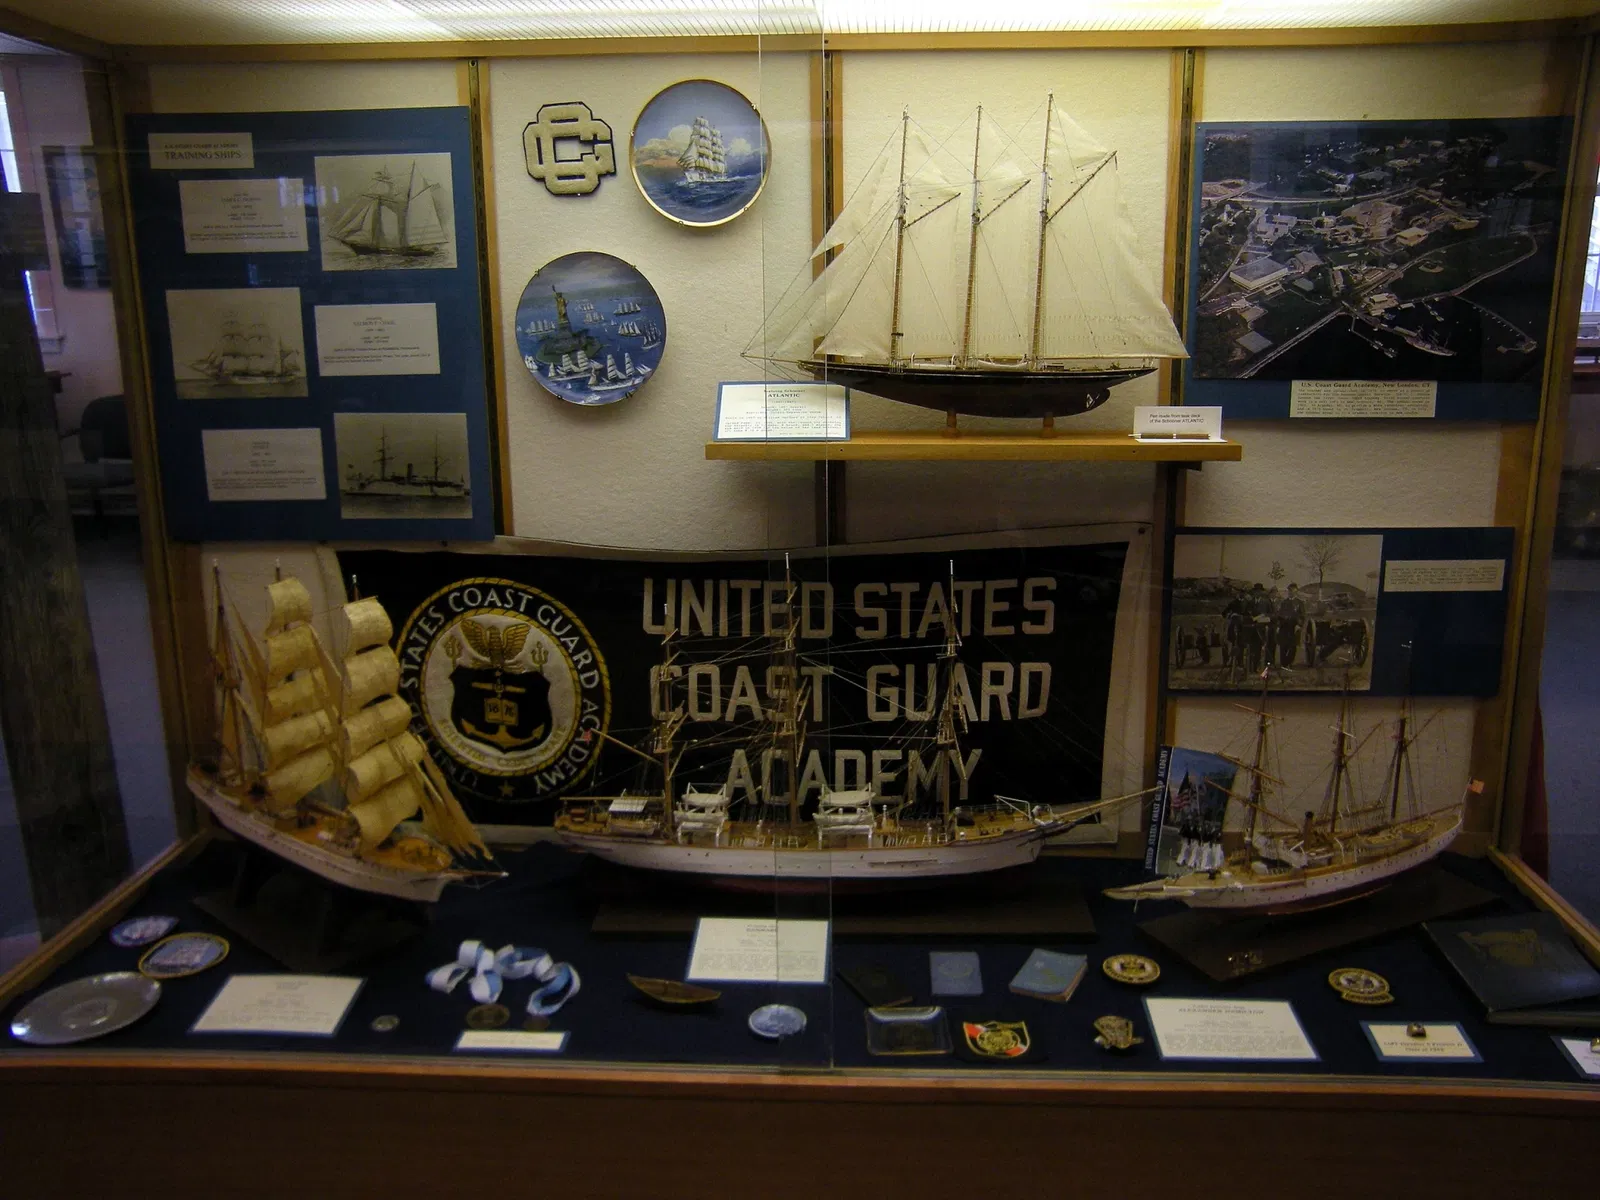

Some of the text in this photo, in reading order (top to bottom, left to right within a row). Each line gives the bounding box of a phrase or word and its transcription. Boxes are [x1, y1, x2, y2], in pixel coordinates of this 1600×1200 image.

[164, 150, 242, 160] TRAINING SHIPS
[642, 577, 1058, 640] UNITED STATES
[402, 606, 445, 689] STATES
[448, 587, 534, 613] COAST
[537, 604, 600, 689] GUARD
[649, 661, 1052, 722] COAST GUARD
[726, 748, 983, 806] ACADEMY
[1158, 750, 1168, 778] ACADEMY
[1152, 803, 1160, 822] COAST
[1148, 824, 1158, 846] STATES
[1145, 846, 1154, 870] UNITED
